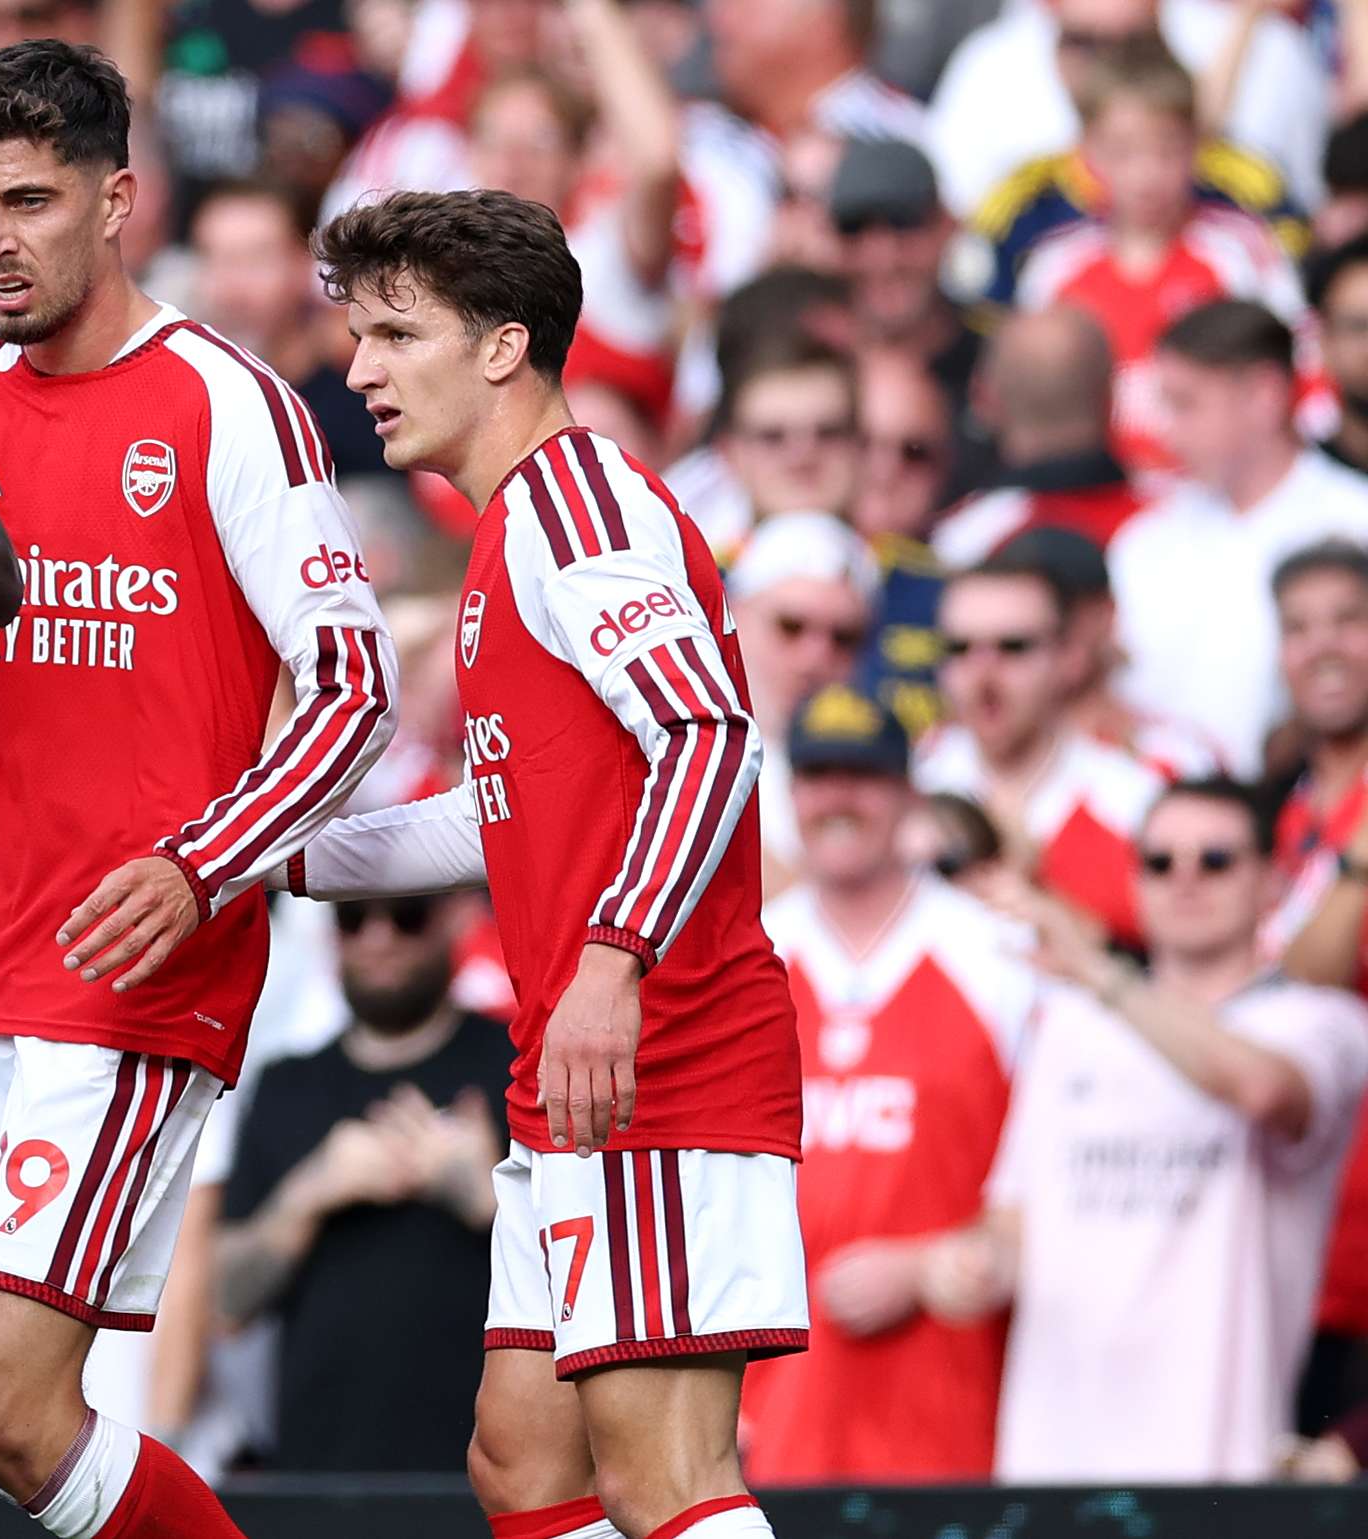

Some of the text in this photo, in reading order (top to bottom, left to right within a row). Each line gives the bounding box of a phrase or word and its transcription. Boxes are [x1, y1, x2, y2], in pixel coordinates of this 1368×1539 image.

[18, 544, 179, 616] irates
[300, 543, 370, 590] dee
[32, 616, 136, 671] BETTER
[472, 773, 512, 827] TER
[800, 1075, 916, 1153] VC
[538, 1215, 595, 1328] 7
